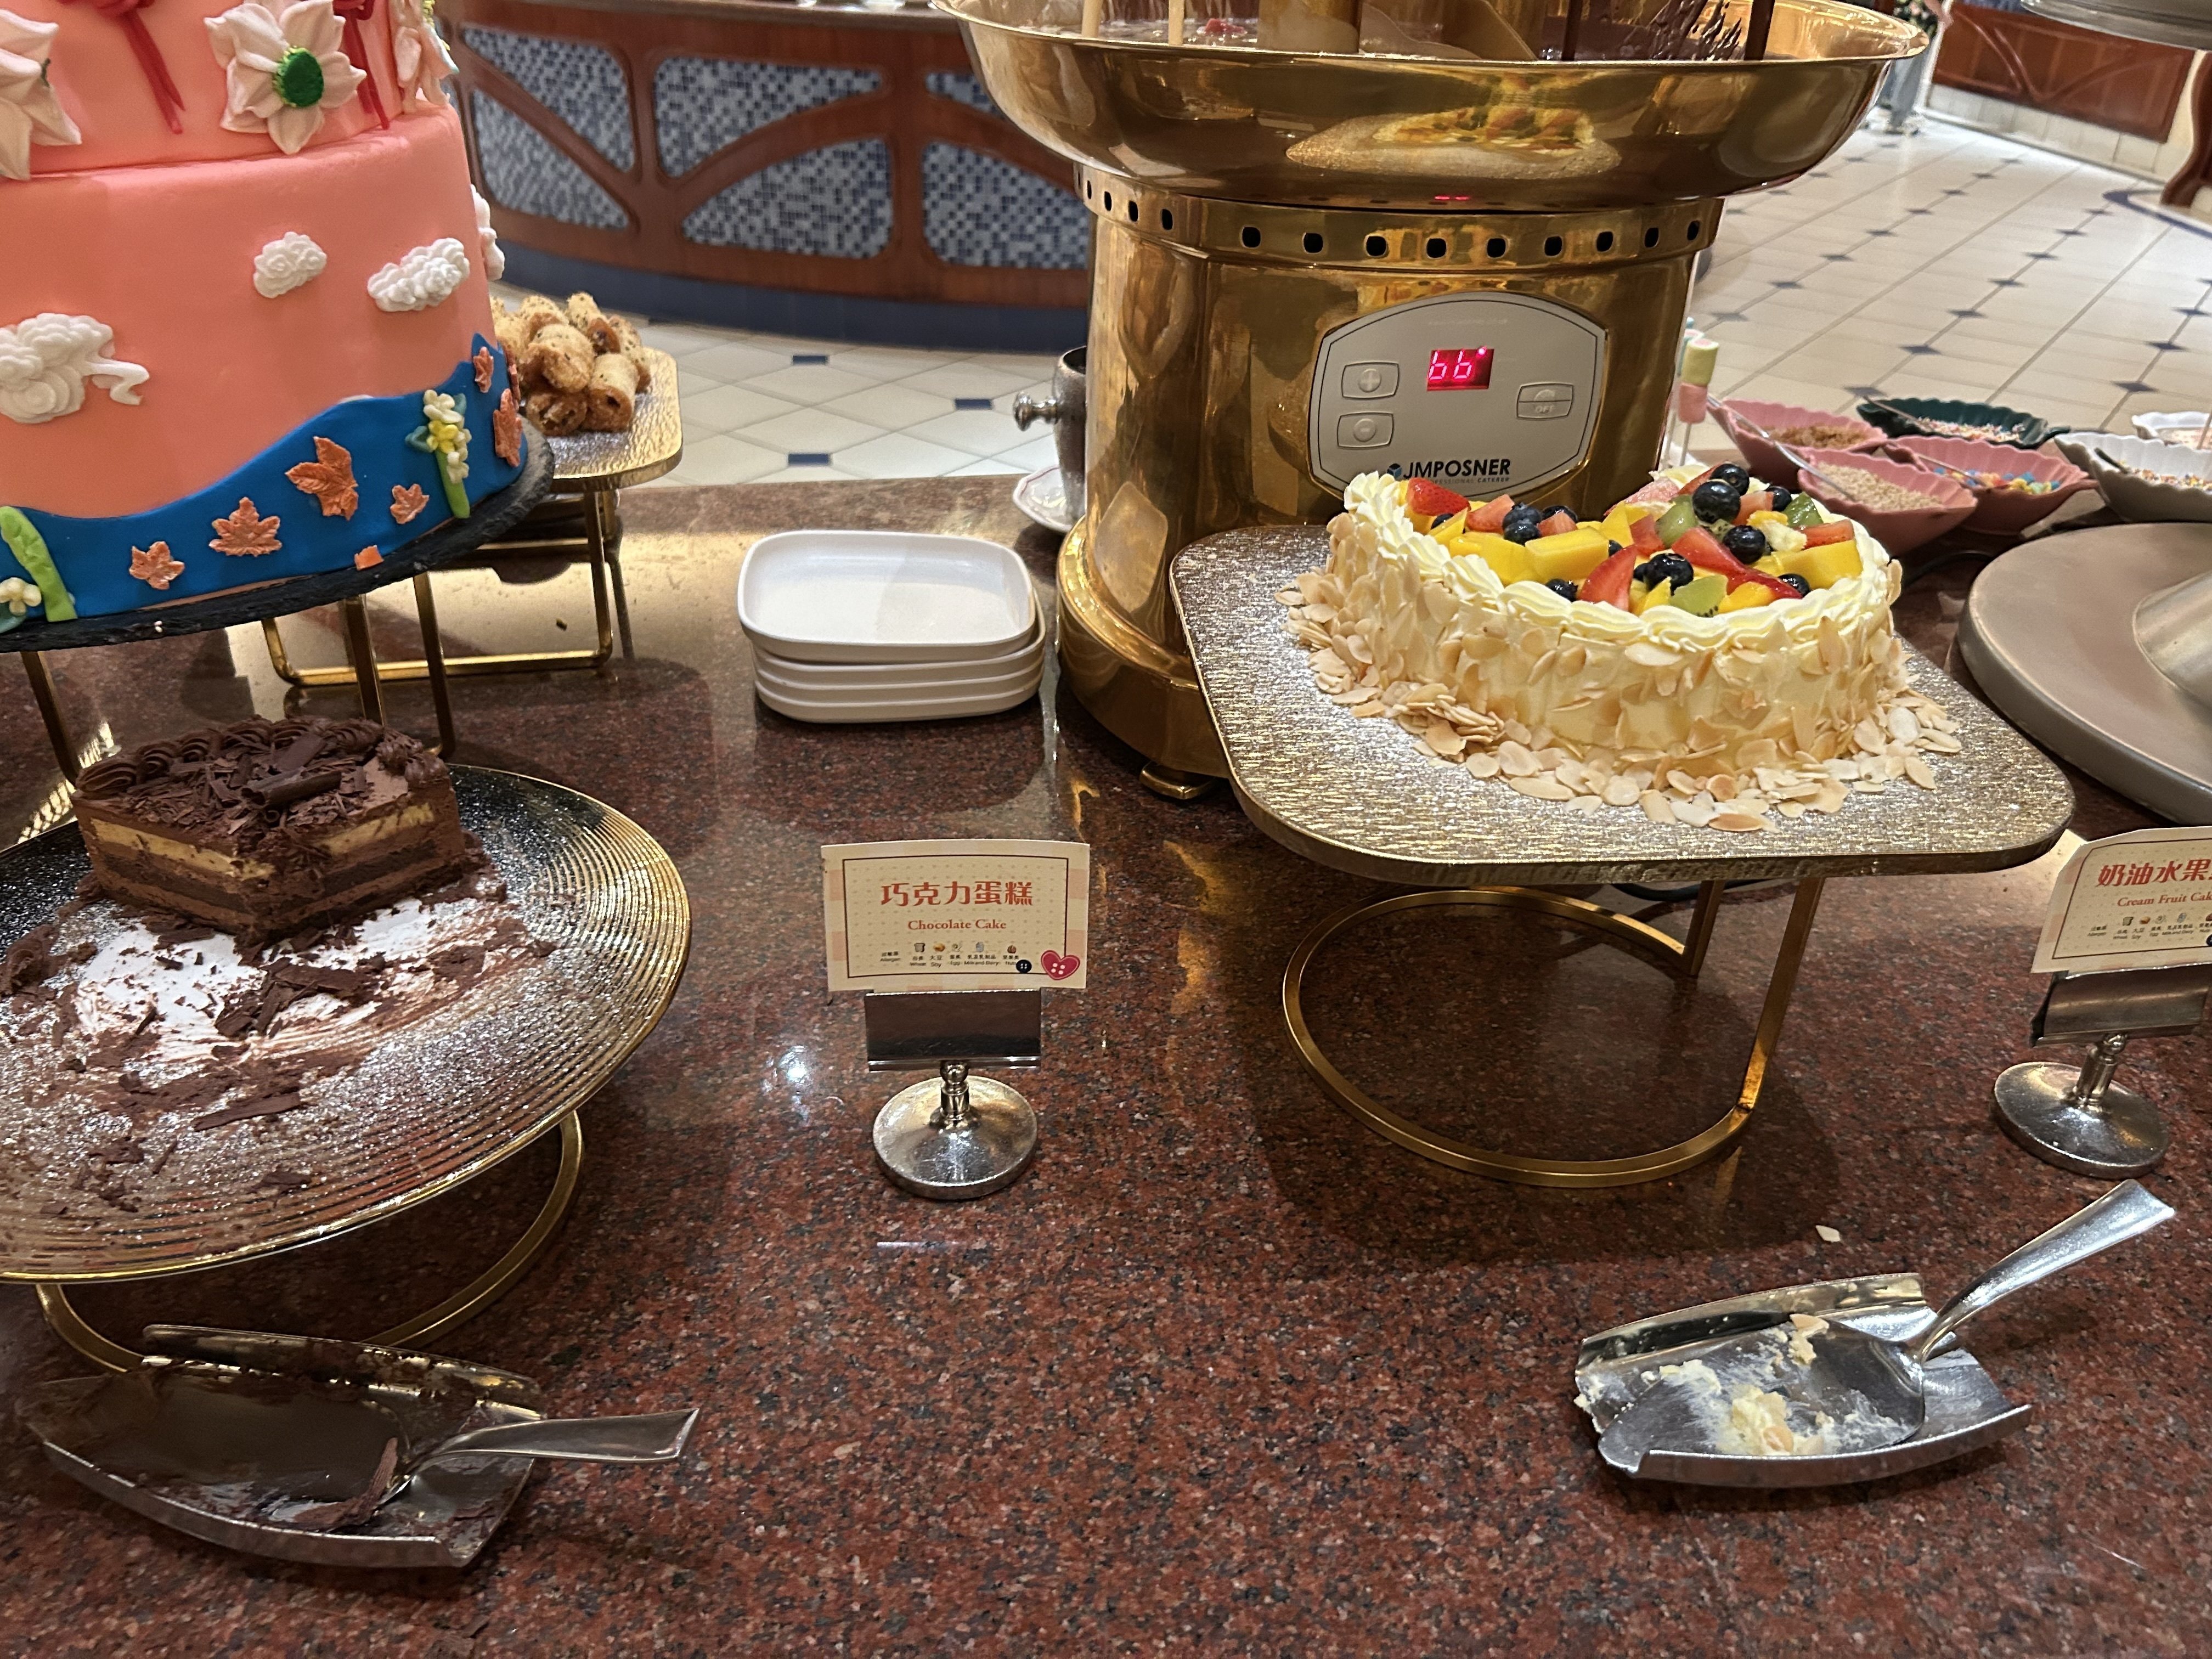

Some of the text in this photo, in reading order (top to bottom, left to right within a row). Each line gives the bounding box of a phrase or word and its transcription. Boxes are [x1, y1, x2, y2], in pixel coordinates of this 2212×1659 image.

[1403, 459, 1511, 479] JMPOSNER
[2095, 859, 2212, 887] 奶油水果
[880, 881, 1033, 907] 巧克力蛋糕
[2117, 891, 2212, 907] Cream Fruit Cak
[907, 918, 1007, 930] Chocolate Cake
